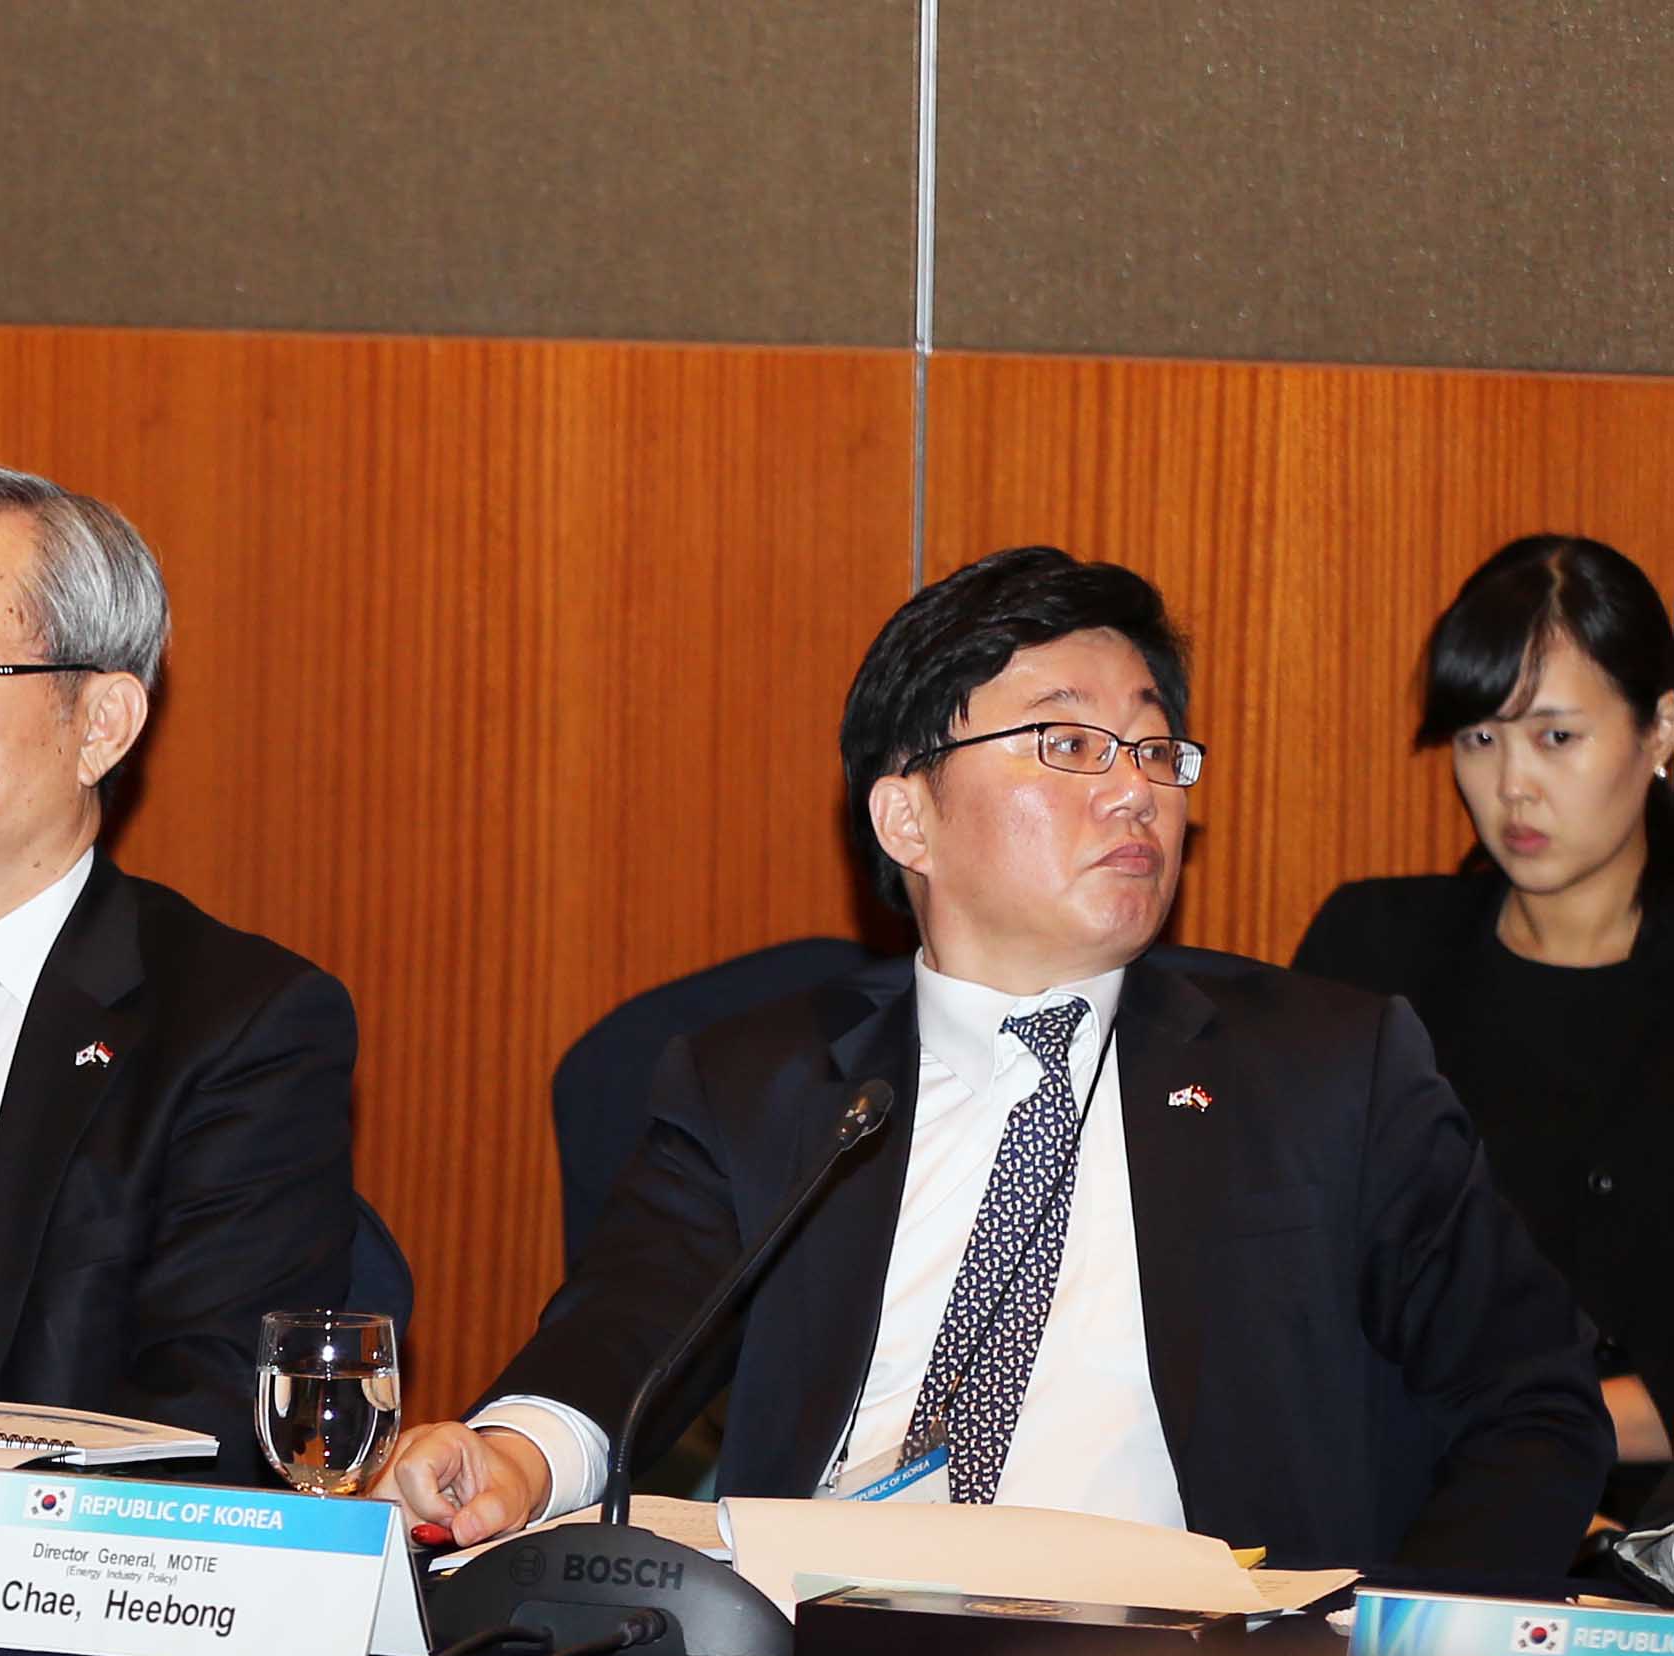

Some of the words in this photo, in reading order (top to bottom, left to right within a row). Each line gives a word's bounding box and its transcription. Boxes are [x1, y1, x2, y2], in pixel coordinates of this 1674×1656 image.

[79, 1496, 178, 1521] REPUBLIC
[180, 1503, 211, 1525] OF
[213, 1505, 284, 1530] KOREA
[32, 1543, 89, 1563] Director
[97, 1548, 157, 1570] General,
[167, 1553, 218, 1573] MOTIE
[66, 1565, 101, 1580] (Energy
[106, 1569, 143, 1583] Industry
[563, 1553, 684, 1590] BOSCH
[1, 1580, 82, 1622] Chae,
[104, 1589, 235, 1637] Heebong
